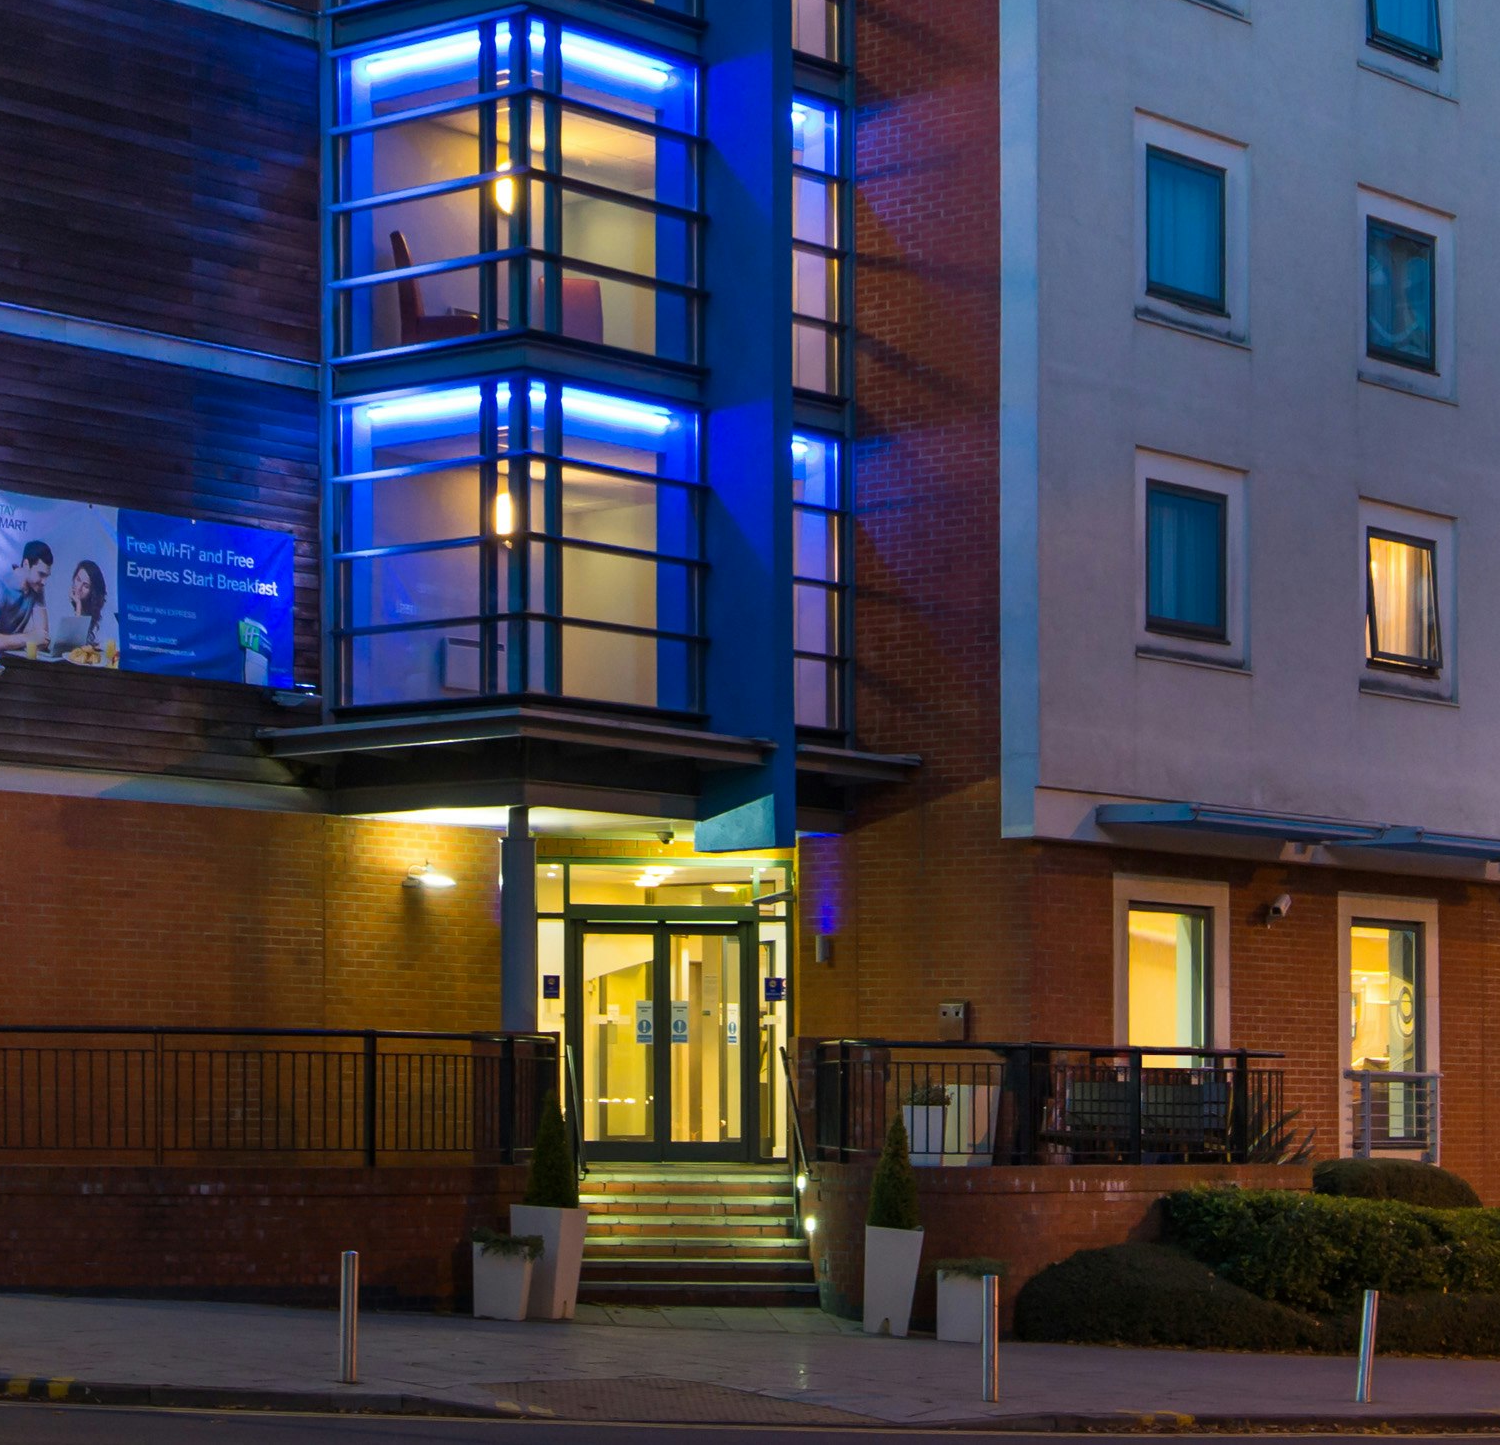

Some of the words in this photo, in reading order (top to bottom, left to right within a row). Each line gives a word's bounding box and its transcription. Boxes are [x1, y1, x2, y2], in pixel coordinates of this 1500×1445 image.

[126, 535, 157, 555] Free
[198, 549, 223, 565] and
[226, 550, 255, 569] Free
[126, 561, 180, 582] Express
[182, 569, 214, 588] Start
[217, 574, 279, 597] Breakfast
